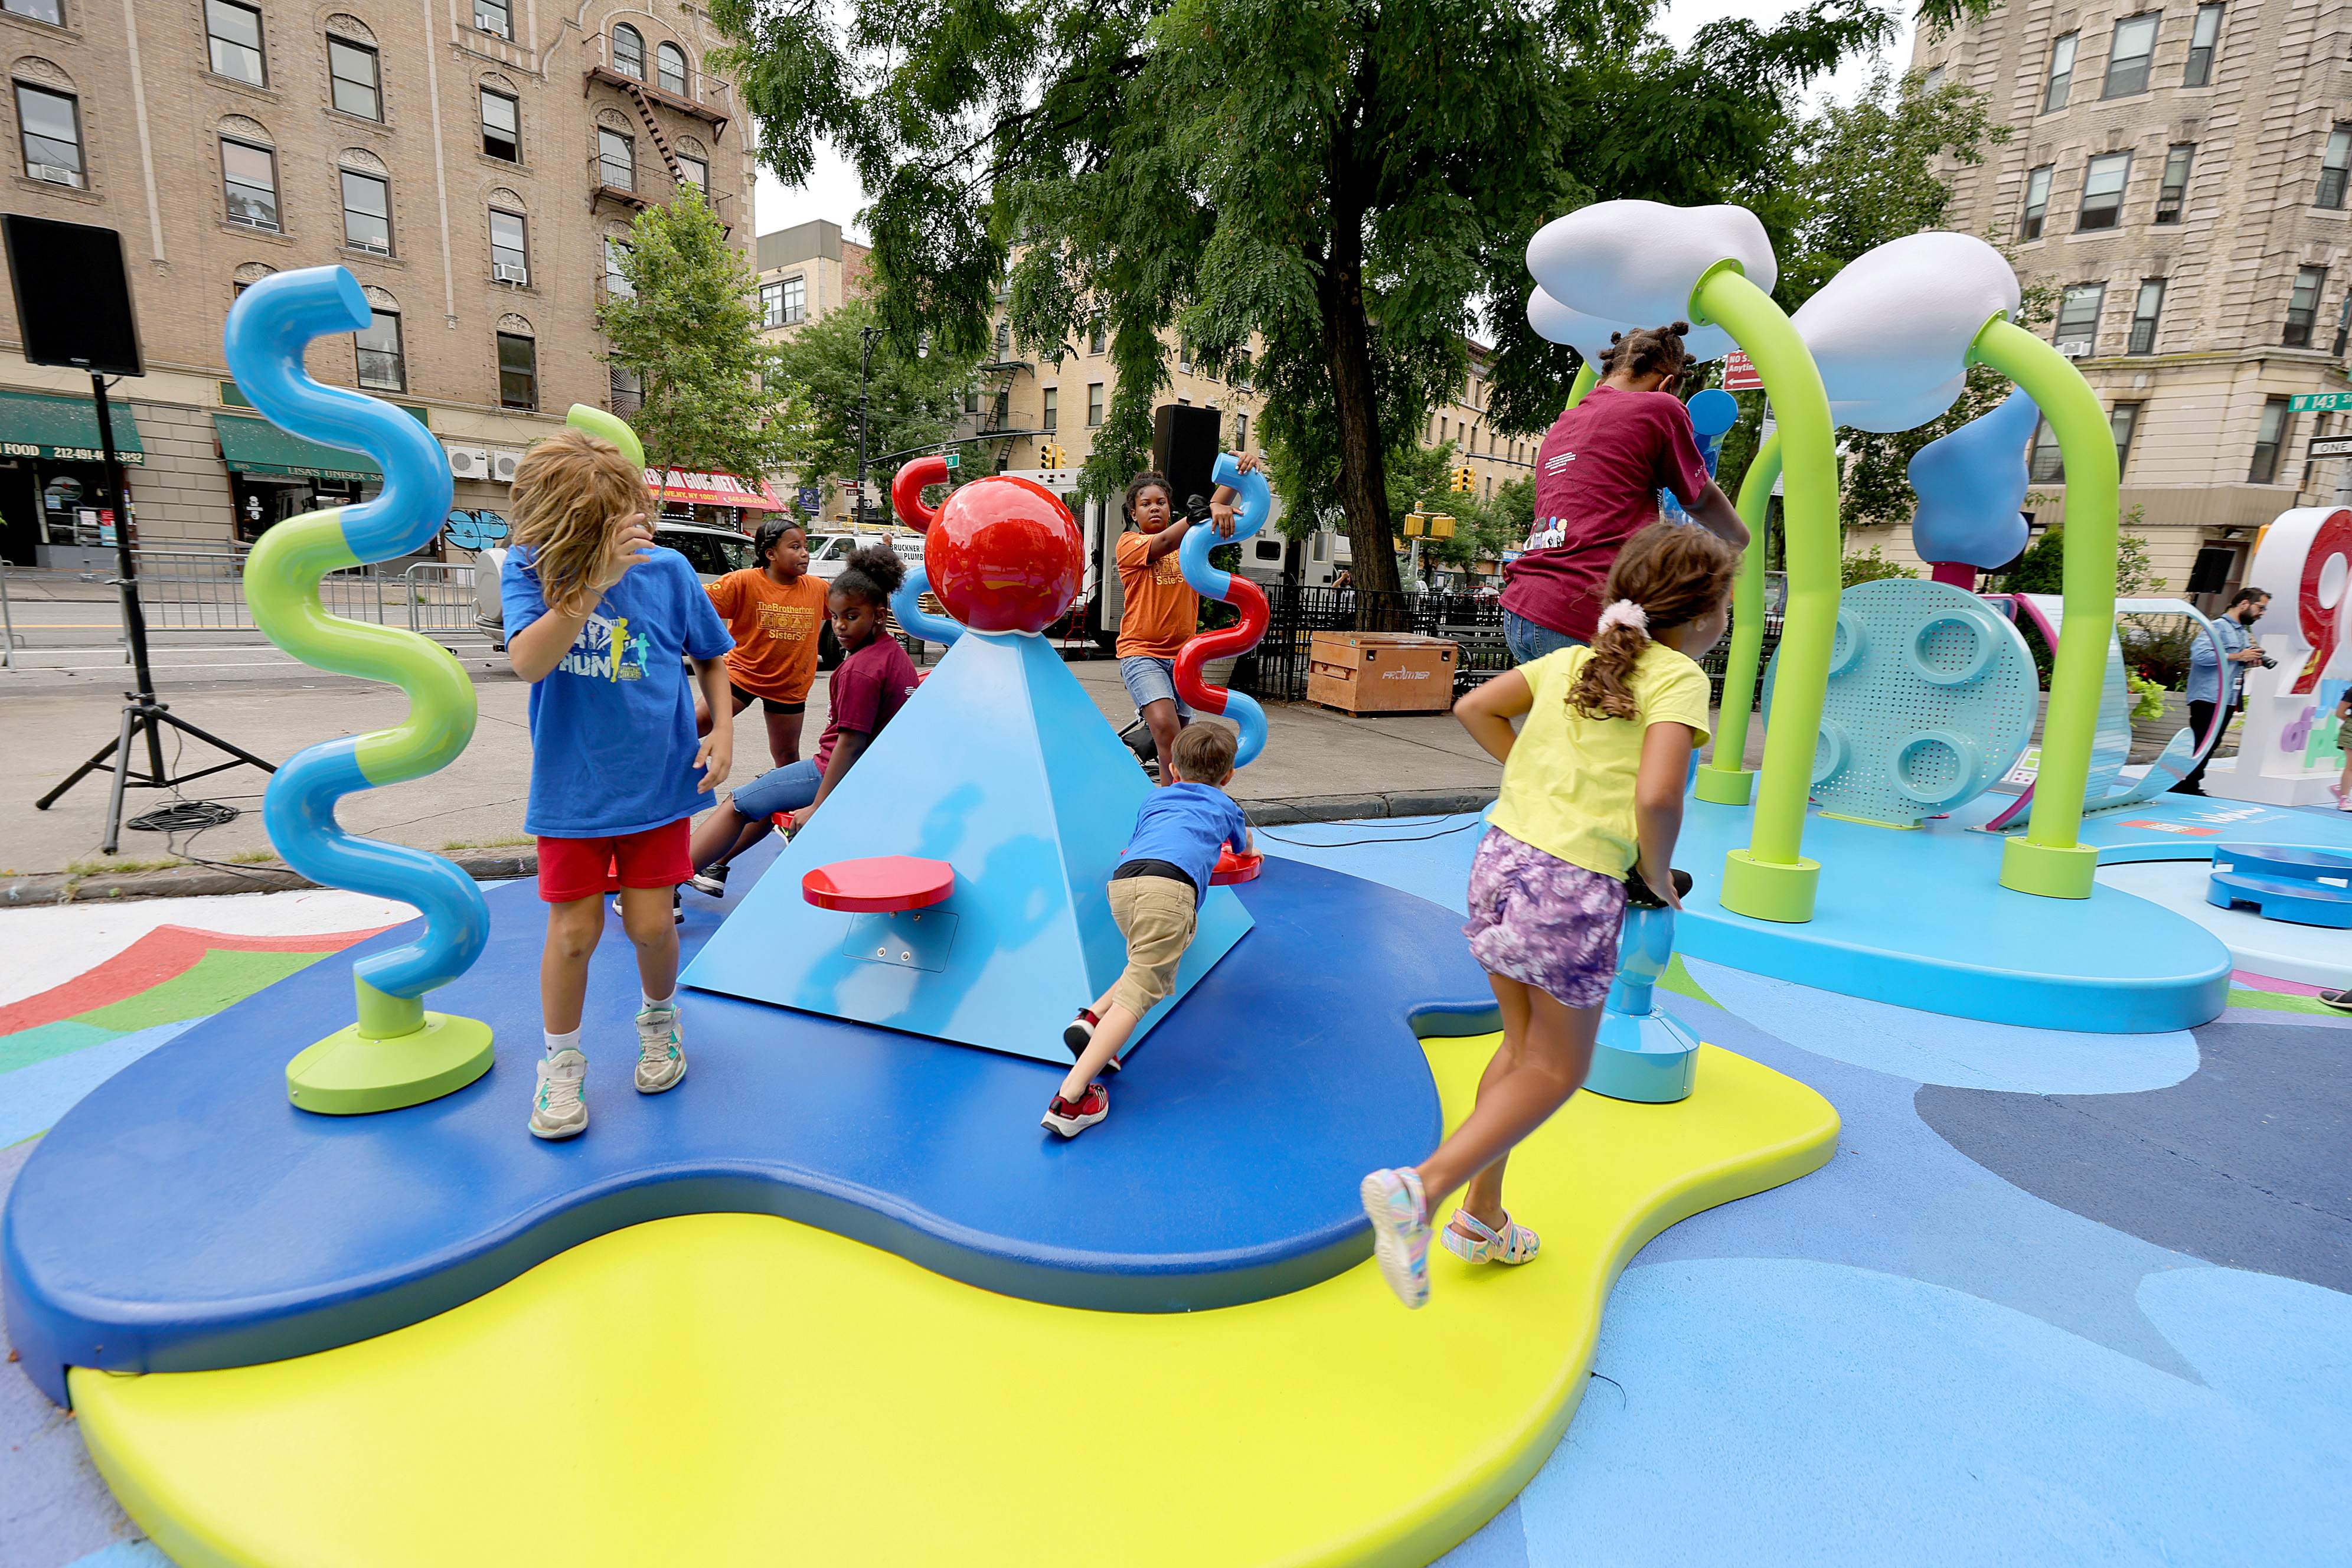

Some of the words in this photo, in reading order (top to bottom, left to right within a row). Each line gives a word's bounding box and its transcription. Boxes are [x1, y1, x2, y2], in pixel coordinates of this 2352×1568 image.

[2294, 396, 2308, 409] W
[2311, 395, 2338, 409] 143
[4, 443, 40, 456] FOOD
[2320, 442, 2349, 453] ONE
[325, 471, 366, 480] UNISEX
[890, 544, 920, 553] BRUCKNER
[904, 553, 924, 561] PLUMB
[1157, 574, 1184, 585] SisterS
